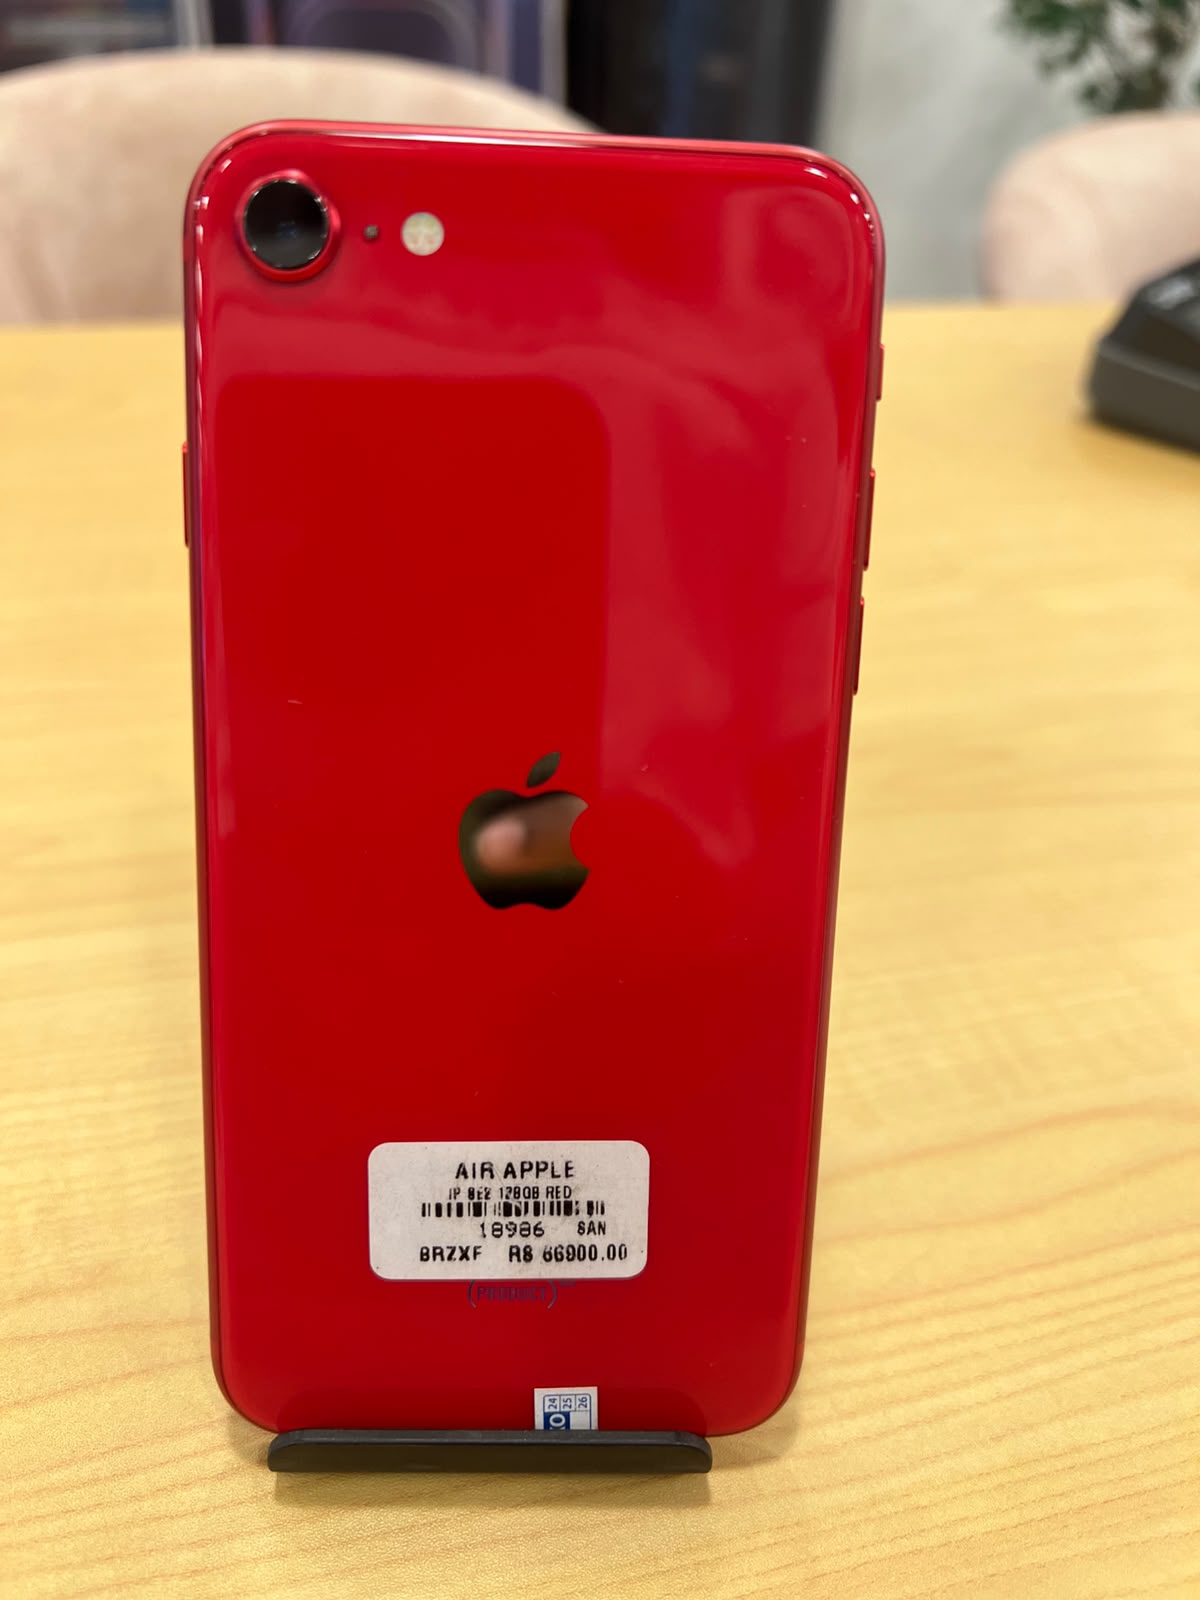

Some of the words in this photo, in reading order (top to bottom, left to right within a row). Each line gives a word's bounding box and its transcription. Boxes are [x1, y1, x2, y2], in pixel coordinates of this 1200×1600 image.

[455, 1162, 495, 1179] AIR
[503, 1160, 575, 1179] APPLE
[449, 1187, 461, 1200] IP
[546, 1186, 572, 1199] RED
[479, 1221, 545, 1238] 18986
[548, 1397, 557, 1409] 24
[563, 1397, 572, 1409] 25
[578, 1396, 587, 1408] 26
